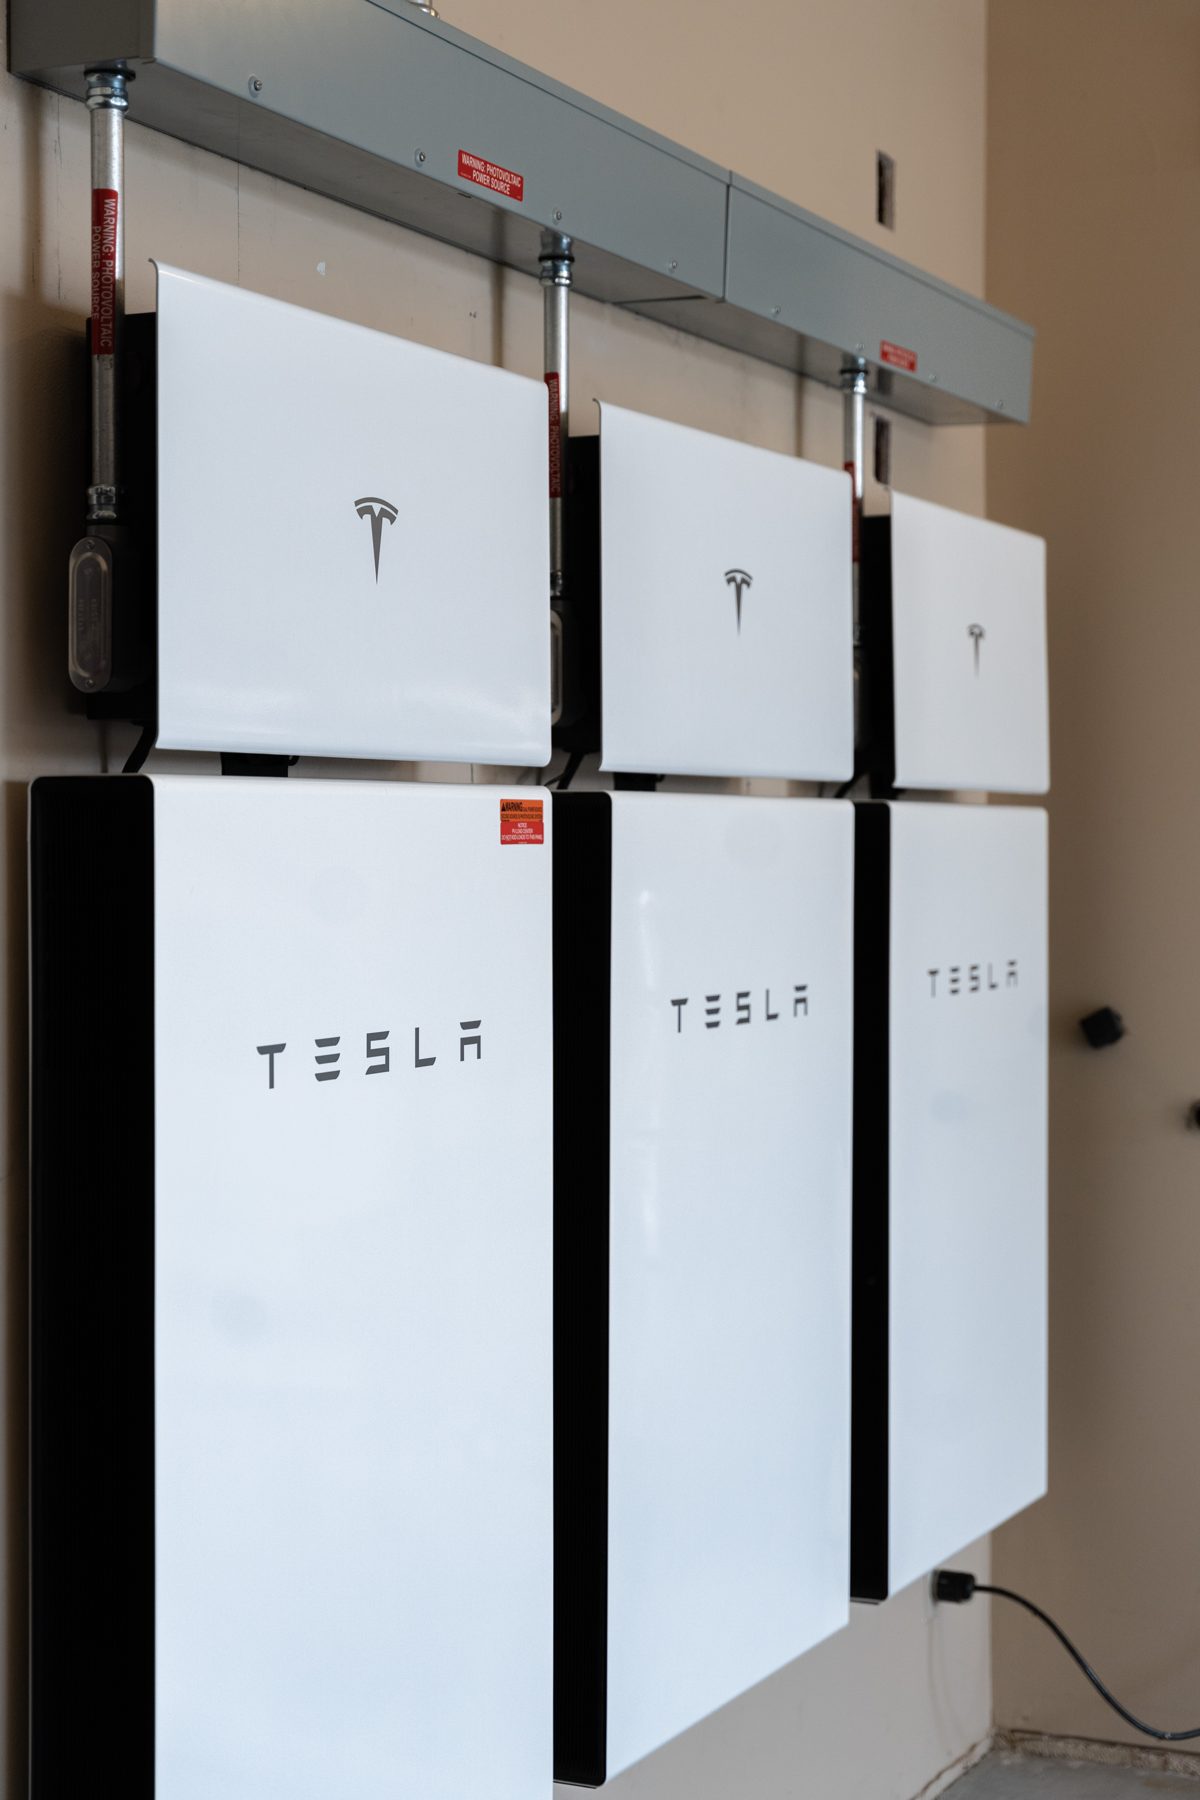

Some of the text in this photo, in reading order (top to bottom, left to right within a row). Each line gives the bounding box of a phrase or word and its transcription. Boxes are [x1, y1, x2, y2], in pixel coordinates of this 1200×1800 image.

[462, 153, 522, 188] WARNING: PHOTOVOLTAIC
[473, 169, 510, 195] POWER SOURCE
[92, 226, 102, 320] POWER SOURCE
[100, 199, 116, 347] WARNING: PHOTOVOLTAIC
[928, 961, 1016, 995] TESLA
[671, 985, 808, 1033] TESLA
[256, 1020, 482, 1089] TESLA
